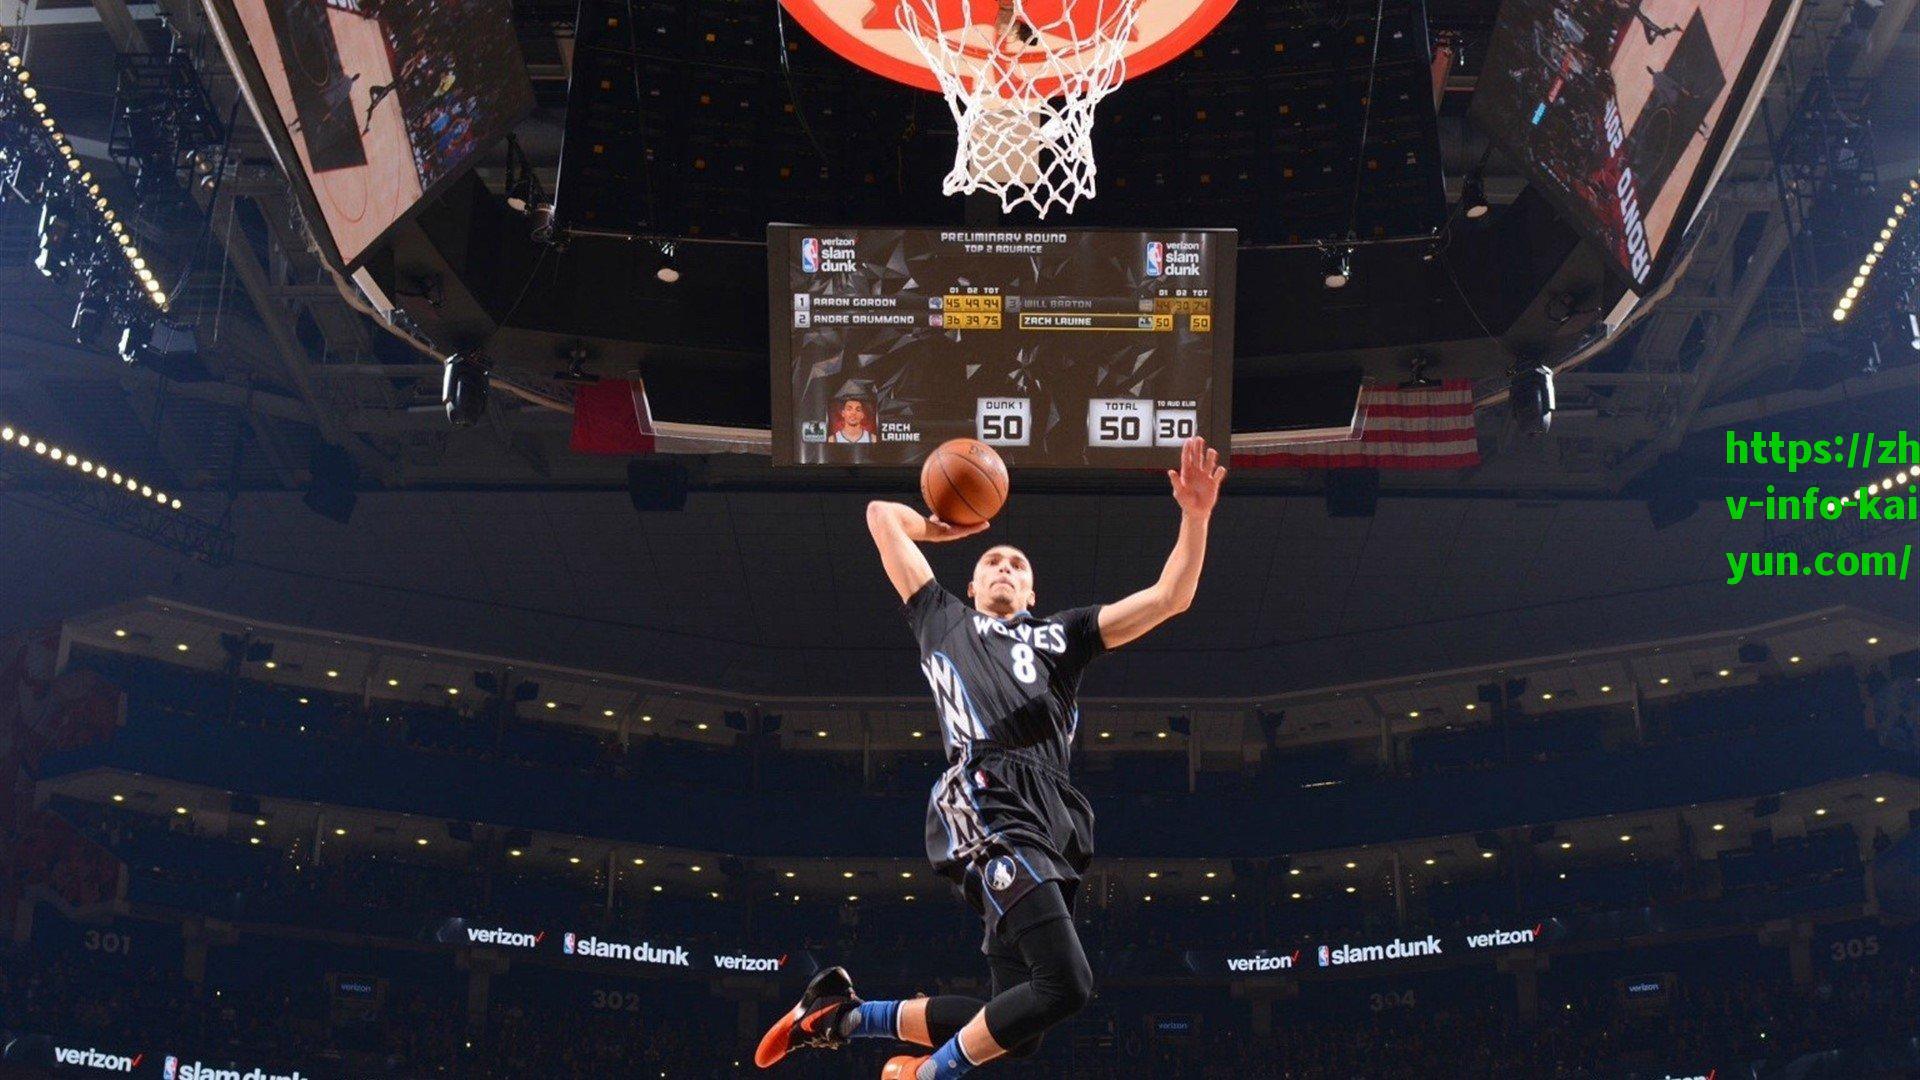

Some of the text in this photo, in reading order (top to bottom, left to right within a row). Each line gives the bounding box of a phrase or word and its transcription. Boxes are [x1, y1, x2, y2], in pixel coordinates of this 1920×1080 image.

[821, 237, 855, 246] verizon
[940, 232, 1067, 244] PRELIMINARY ROUND
[964, 244, 984, 253] TOP
[986, 245, 993, 253] 2
[1166, 241, 1200, 250] verizon
[821, 246, 856, 260] slam
[1166, 250, 1200, 263] slam
[821, 259, 857, 272] dunk
[1165, 263, 1200, 276] dunk
[1192, 289, 1208, 297] TOT
[813, 298, 850, 307] AARON
[853, 298, 897, 307] GORDON
[946, 299, 960, 308] 45
[965, 299, 980, 308] 49
[983, 299, 999, 308] 94
[798, 315, 806, 324] 2
[813, 315, 850, 324] ANDRE
[852, 315, 915, 325] DRUMMOND
[965, 316, 980, 325] 39
[984, 316, 999, 326] 75
[1024, 316, 1052, 326] ZACH
[1156, 318, 1170, 327] 50
[1193, 318, 1208, 327] 50
[986, 401, 1015, 410] DUNK
[1105, 402, 1138, 411] TOTAL
[881, 423, 911, 432] ZACH
[983, 415, 1023, 440] 50
[1100, 416, 1141, 441] 50
[1159, 418, 1194, 438] 30
[973, 615, 1067, 654] WOLVES
[1010, 642, 1037, 684] 8
[85, 930, 131, 955] 301
[467, 928, 536, 947] verizon
[1466, 929, 1534, 948] verizon
[577, 936, 690, 966] slam dunk
[1331, 935, 1442, 965] slam dunk
[1831, 935, 1880, 961] 305
[714, 954, 779, 971] verizon
[1227, 955, 1292, 971] verizon
[340, 983, 372, 992] verizon
[1629, 983, 1660, 992] verizon
[592, 989, 639, 1012] 302
[54, 1047, 132, 1072] verizon
[178, 1061, 240, 1080] slam
